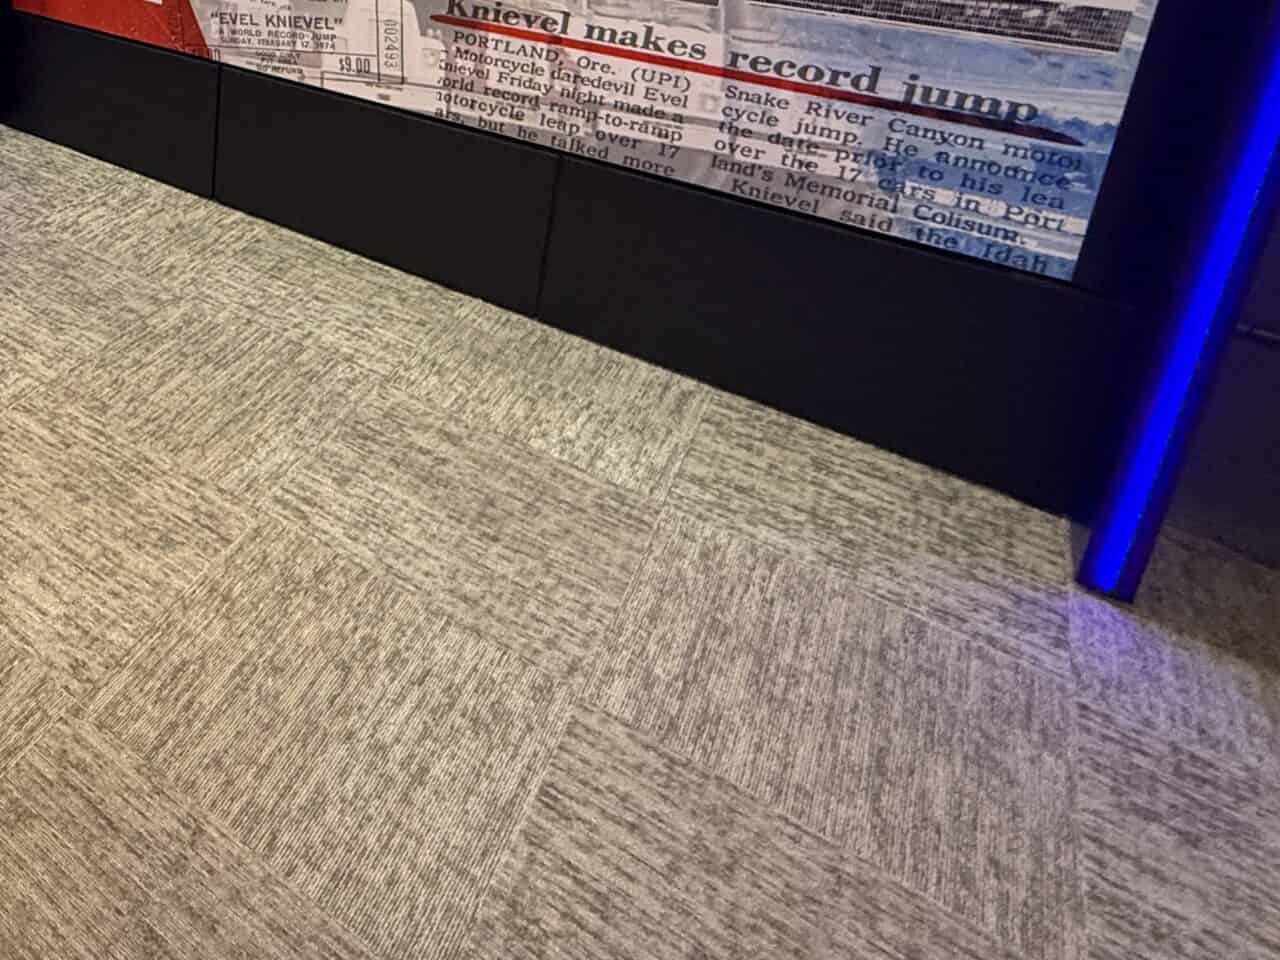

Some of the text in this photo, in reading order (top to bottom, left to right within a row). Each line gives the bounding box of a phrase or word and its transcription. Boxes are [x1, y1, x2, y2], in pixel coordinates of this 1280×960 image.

[338, 55, 371, 74] $9.00
[454, 31, 691, 93] PORTLAND, Ore. (UPI)
[455, 47, 688, 108] Motorcycle daredevil Evel
[584, 23, 708, 61] makes
[727, 49, 882, 94] record
[902, 74, 1039, 124] jump
[484, 86, 541, 109] record
[550, 100, 684, 142] ramp-to-ramp
[497, 72, 553, 96] Friday
[560, 87, 607, 105] night
[614, 99, 669, 120] made
[671, 114, 684, 124] a
[725, 85, 791, 111] Snake
[805, 101, 876, 127] River
[888, 117, 985, 150] Canyon
[478, 117, 506, 134] but
[518, 126, 538, 142] he
[551, 135, 609, 161] talked
[623, 155, 676, 177] more
[540, 113, 581, 137] leap
[595, 130, 641, 150] over
[658, 143, 681, 159] 17
[719, 121, 753, 139] the
[768, 131, 820, 154] date
[834, 148, 904, 172] prior
[918, 164, 944, 182] to
[959, 173, 1004, 195] his
[721, 106, 780, 127] cycle
[793, 118, 863, 146] jump.
[882, 136, 919, 157] He
[711, 155, 774, 183] land's
[784, 173, 900, 213] Memorial
[714, 140, 766, 160] over
[780, 153, 819, 172] the
[837, 165, 863, 183] 17
[878, 178, 935, 201] cars
[956, 191, 980, 213] in
[732, 178, 820, 214] Knievel
[839, 208, 894, 233] said
[913, 227, 959, 250] the
